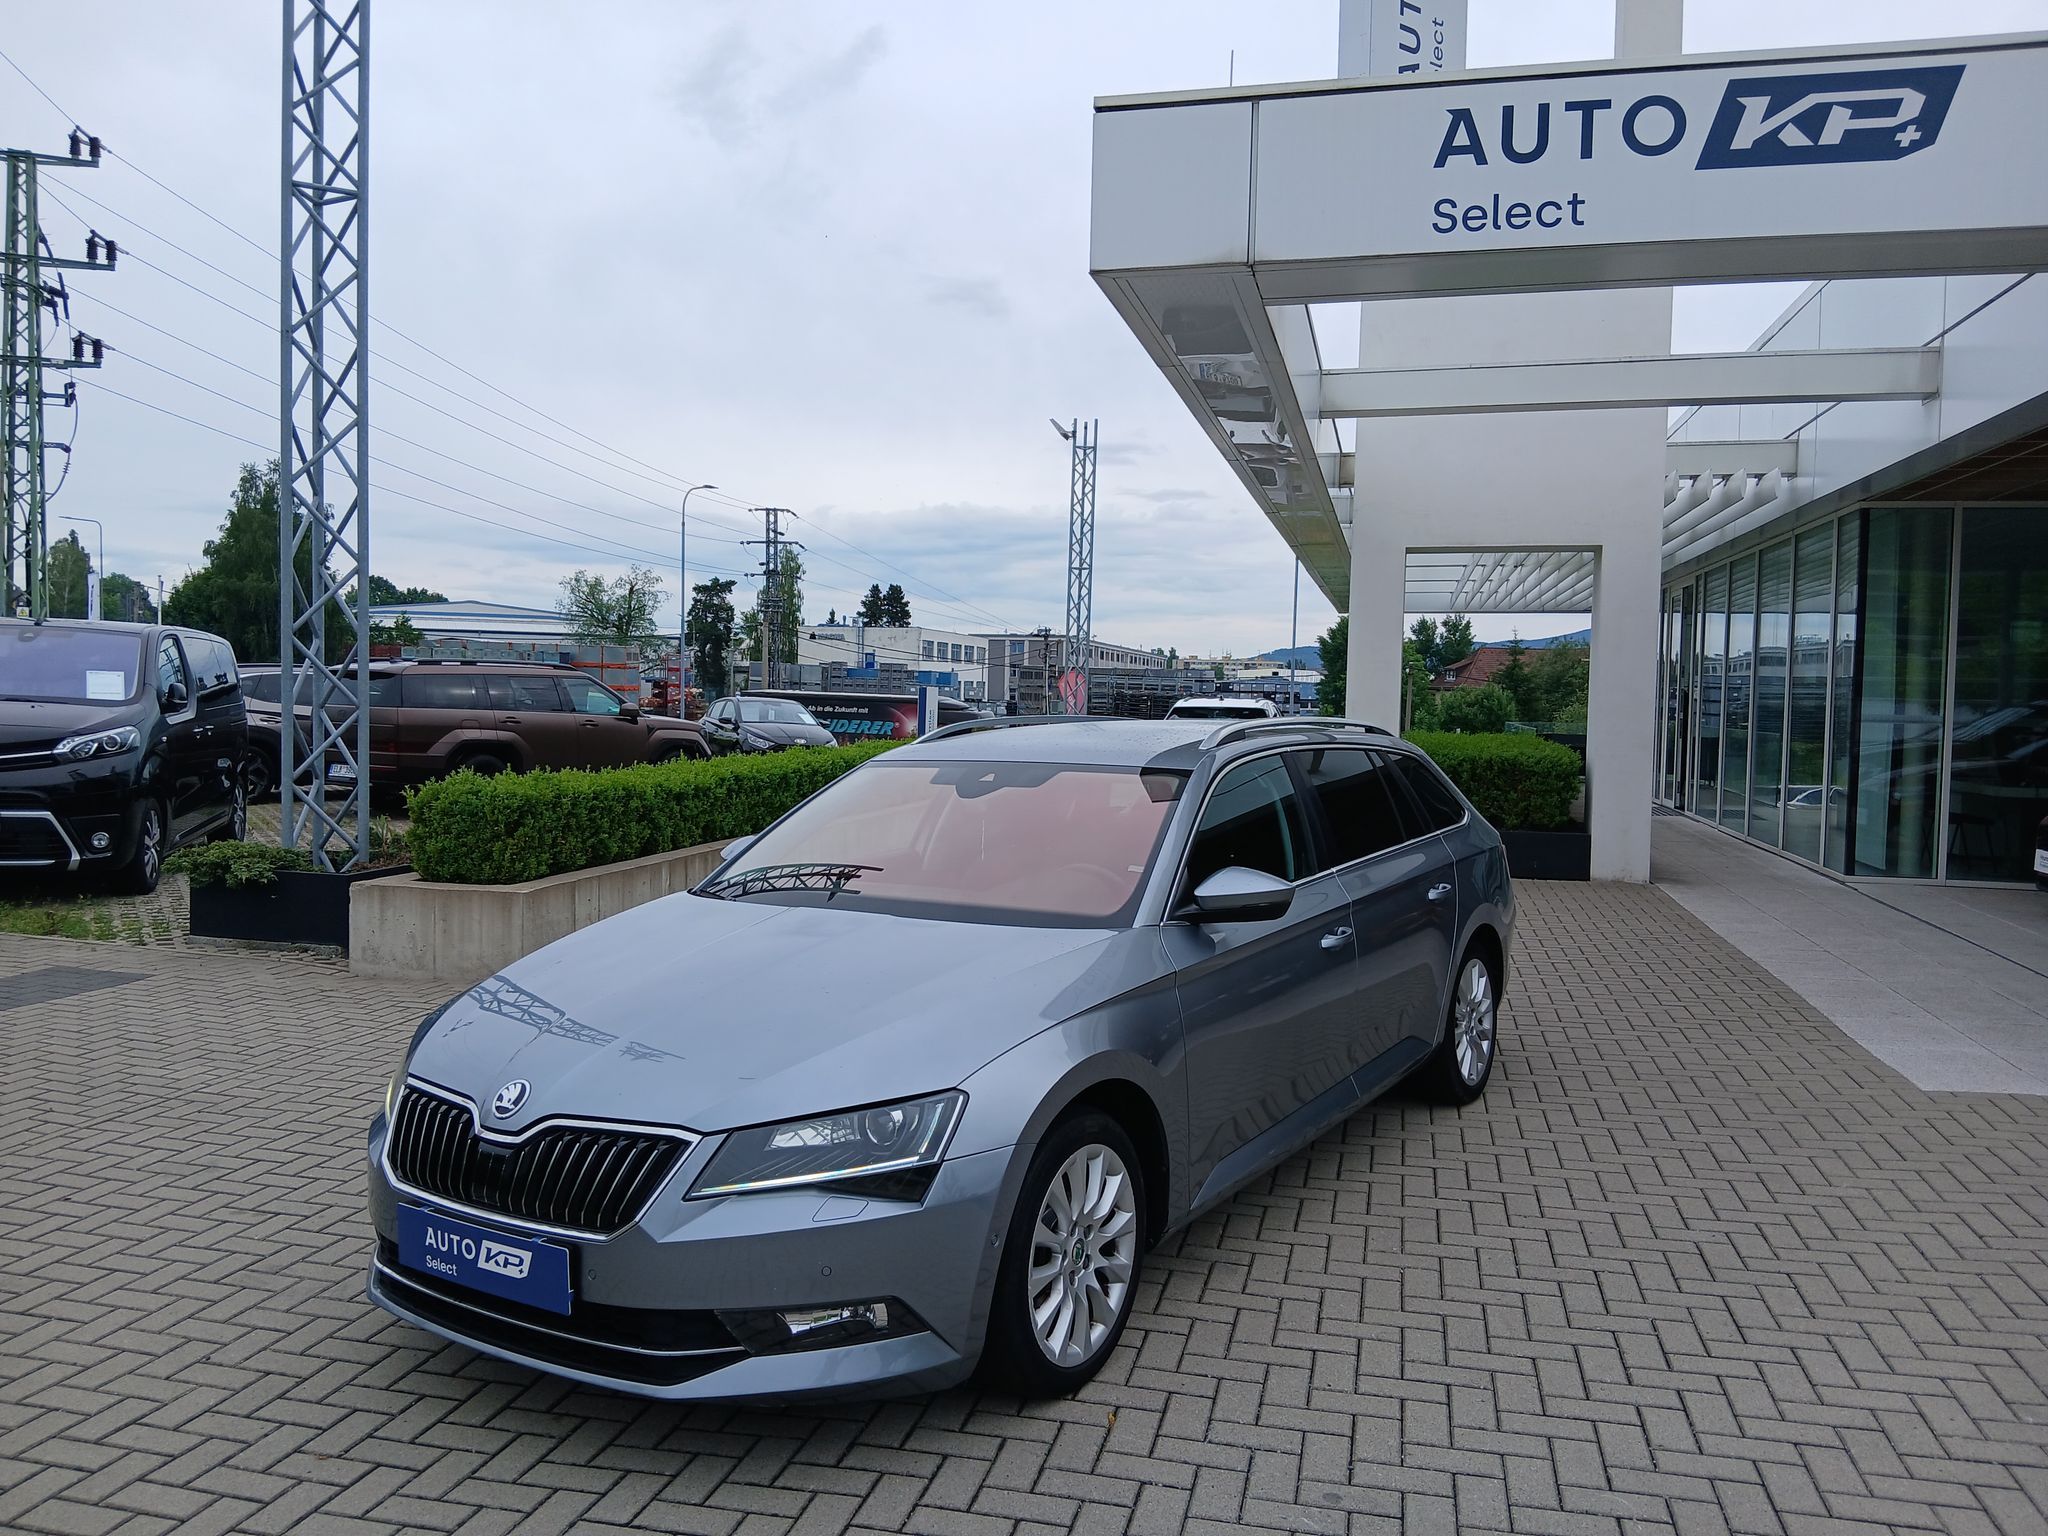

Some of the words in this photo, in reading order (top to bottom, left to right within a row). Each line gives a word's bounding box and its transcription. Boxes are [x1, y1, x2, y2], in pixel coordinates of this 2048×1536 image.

[1433, 95, 1687, 168] AUTO
[1432, 192, 1586, 234] Select
[834, 705, 858, 713] Zukunft
[827, 719, 894, 735] IDERER
[425, 1226, 476, 1260] AUTO
[426, 1255, 458, 1276] Select
